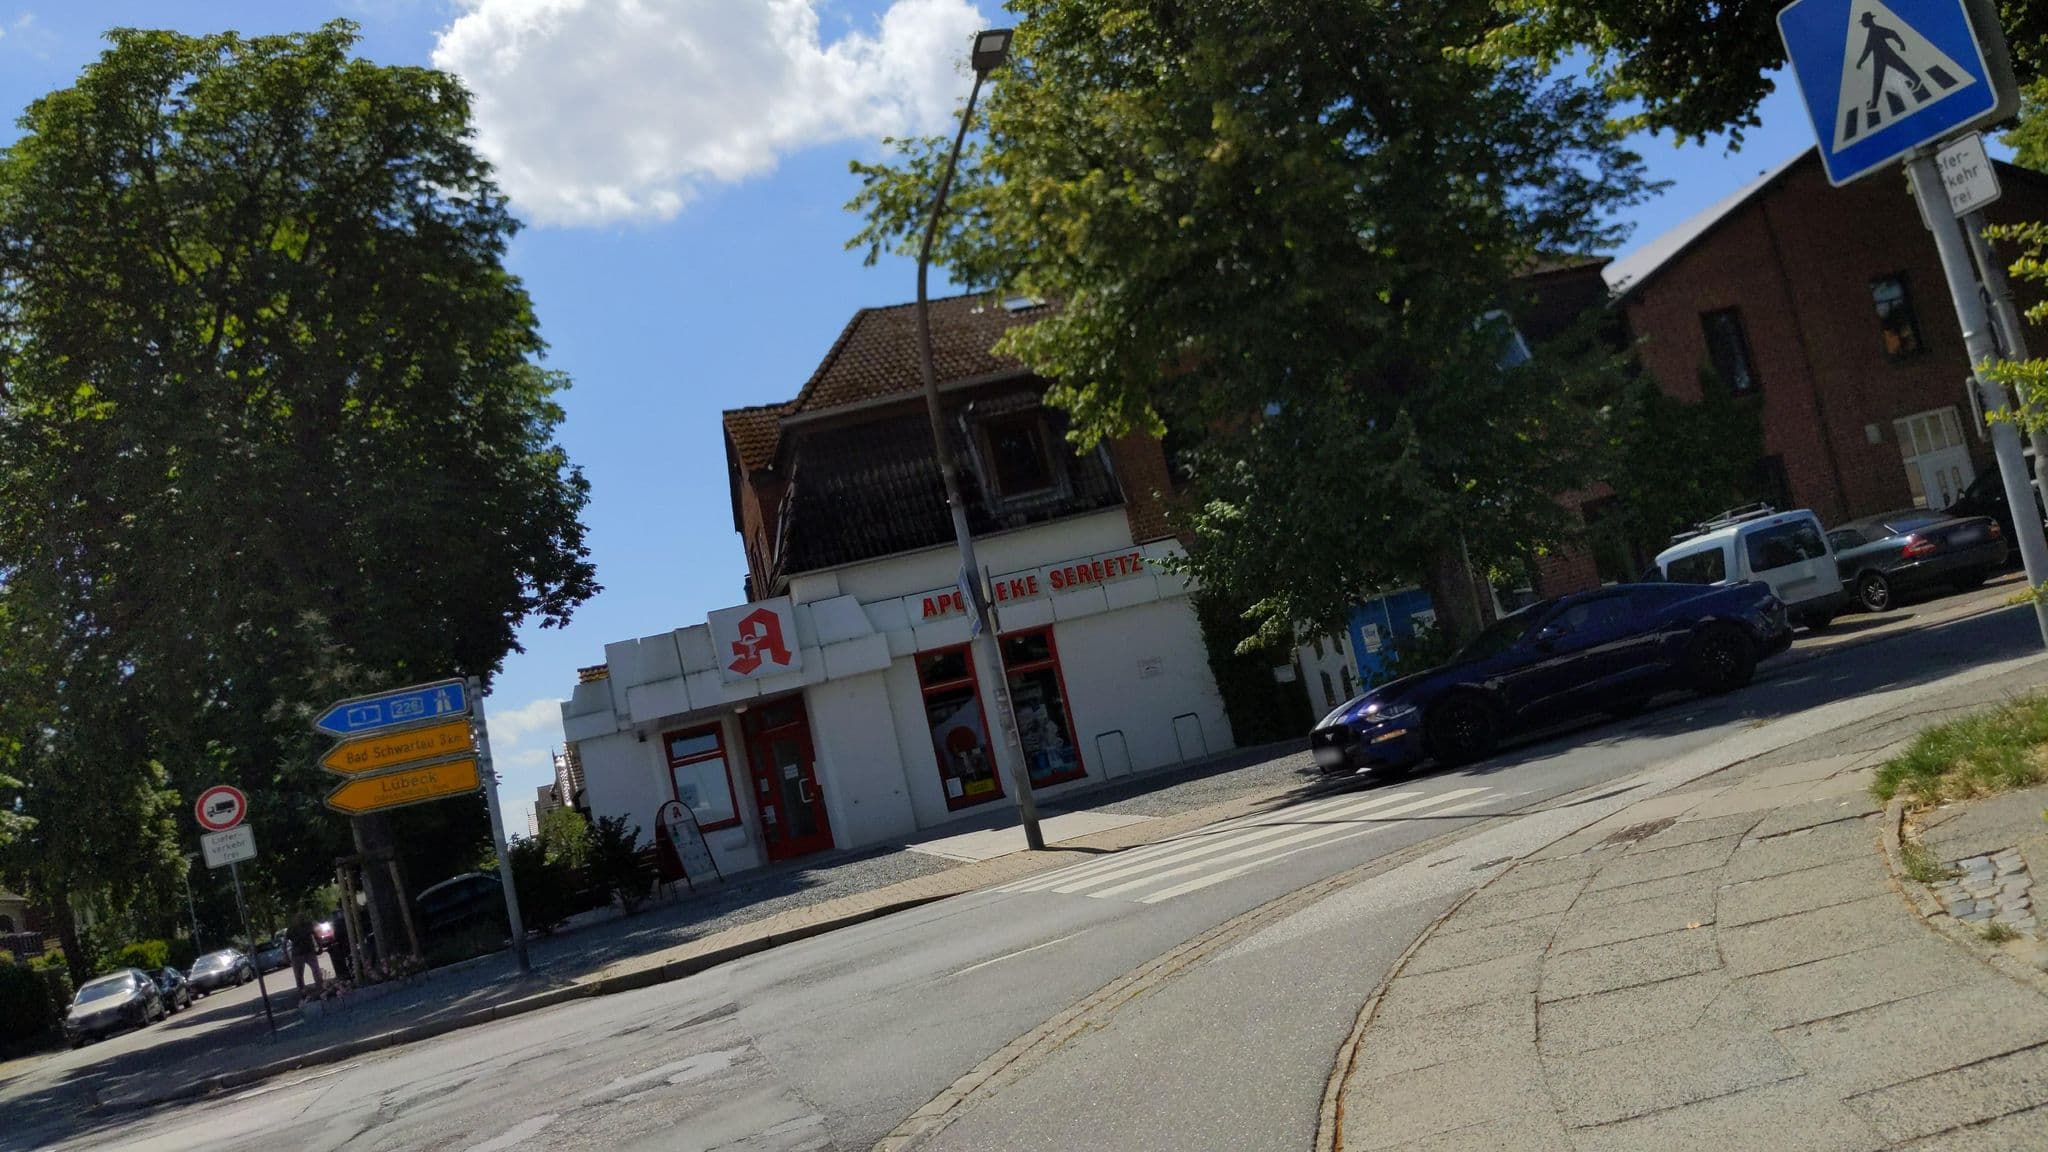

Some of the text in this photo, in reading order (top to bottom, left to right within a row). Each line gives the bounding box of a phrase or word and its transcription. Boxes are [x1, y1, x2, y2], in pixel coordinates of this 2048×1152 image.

[1936, 151, 1969, 172] efer-
[1944, 164, 1979, 187] kehr
[1952, 188, 1972, 208] rei
[922, 552, 1143, 619] APOEKE SEREETZ
[346, 750, 368, 764] Bad
[373, 738, 434, 758] Schwartau
[382, 773, 437, 792] Lübeck
